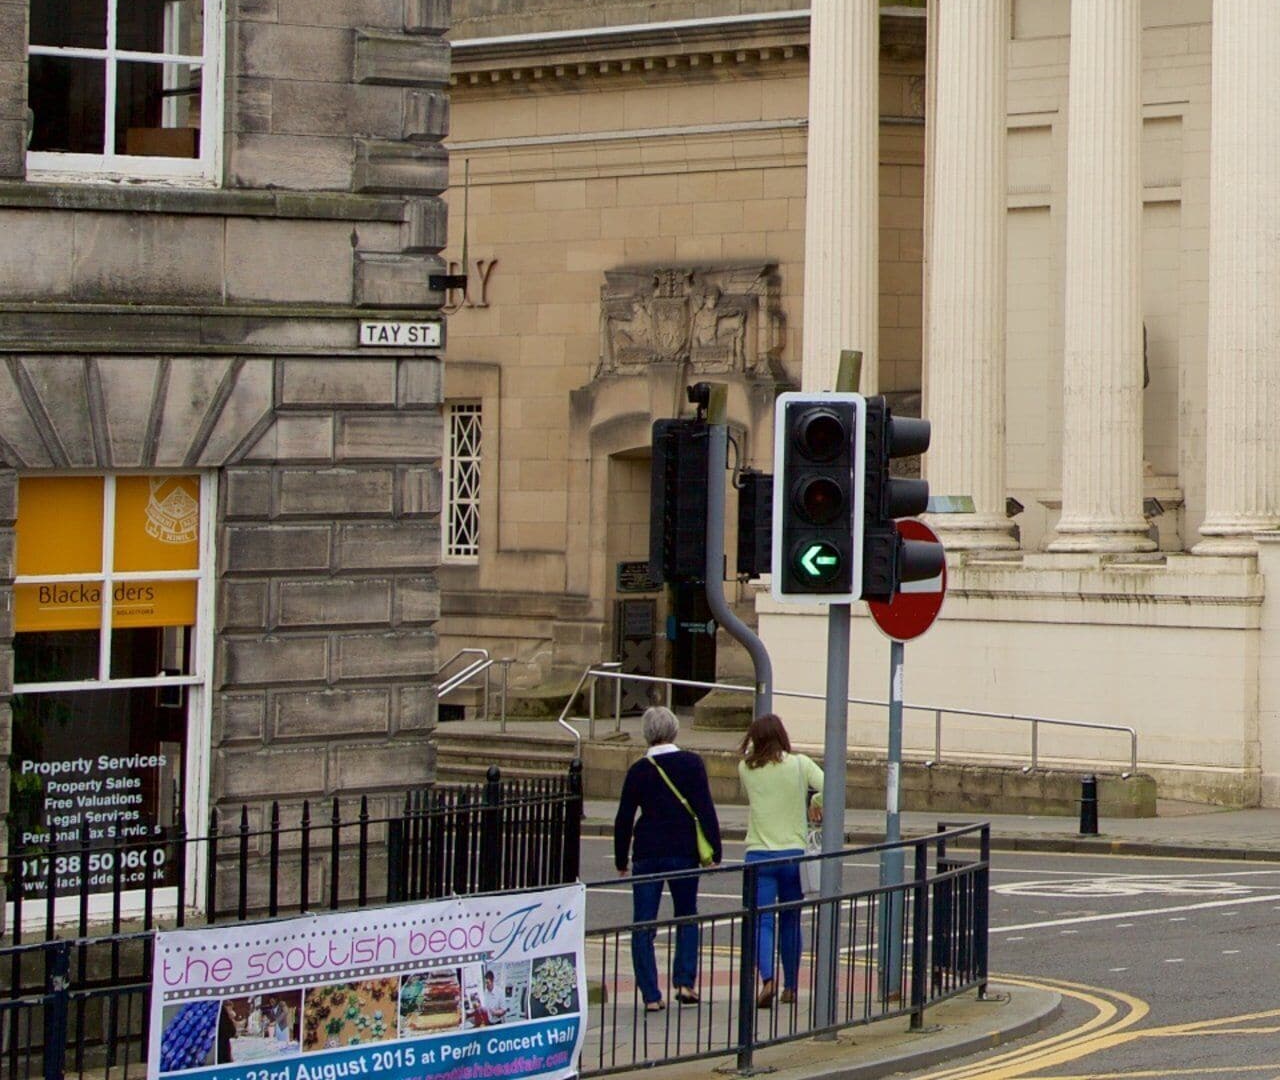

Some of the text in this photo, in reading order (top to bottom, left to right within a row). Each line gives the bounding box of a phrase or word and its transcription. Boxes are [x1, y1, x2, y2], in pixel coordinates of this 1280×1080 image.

[366, 324, 435, 342] TAY ST.
[39, 581, 154, 604] Blackaders
[22, 753, 166, 776] Property Services
[47, 777, 141, 794] Property Sales
[44, 793, 143, 810] Free Valuations
[22, 824, 162, 844] Persnal ax Srvics
[163, 903, 578, 986] the scottish bead Fair
[296, 1056, 368, 1080] August
[373, 1047, 415, 1072] 2015
[421, 1051, 435, 1064] at
[440, 1041, 480, 1061] Perth
[487, 1031, 543, 1055] Concert
[547, 1026, 575, 1046] Hall
